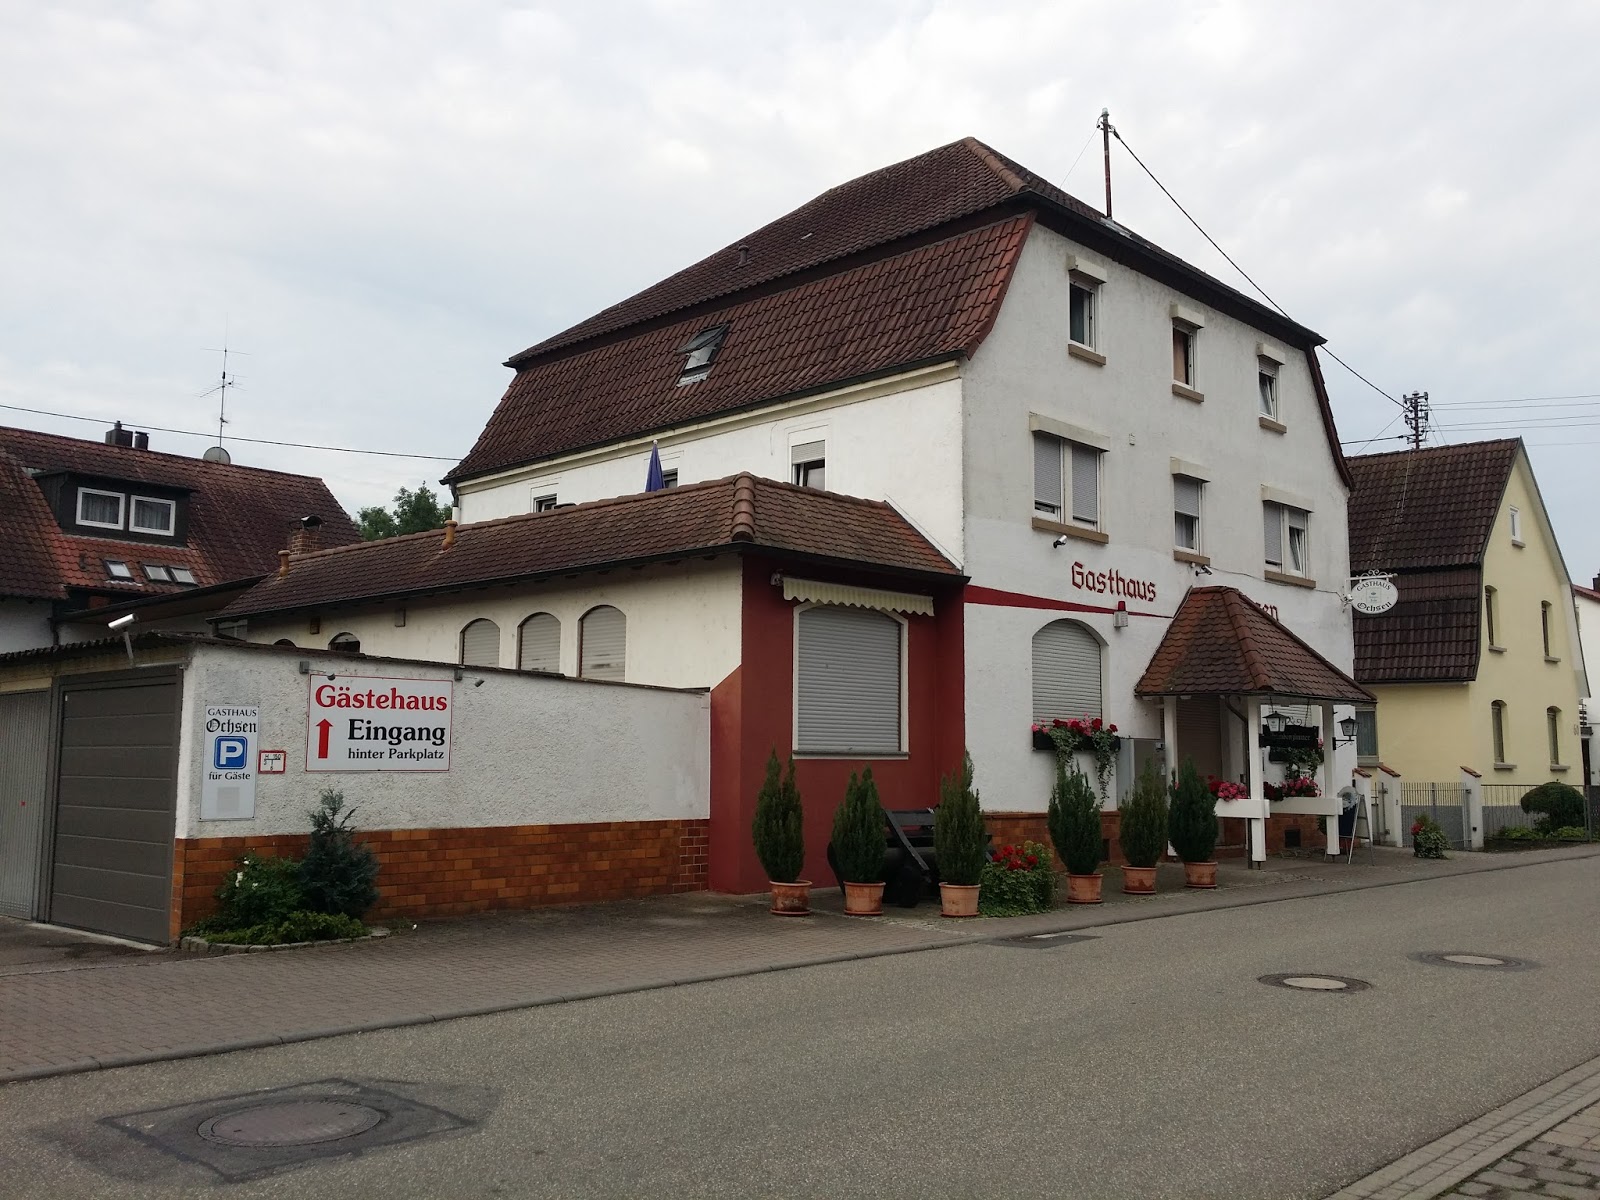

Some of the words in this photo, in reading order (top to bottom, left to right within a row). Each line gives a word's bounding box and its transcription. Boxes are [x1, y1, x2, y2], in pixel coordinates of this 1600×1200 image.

[1071, 561, 1156, 602] Gasthaus
[1356, 580, 1391, 591] GASTHAUS
[1357, 601, 1392, 612] Ochsen
[315, 684, 448, 711] Gästehaus
[207, 708, 257, 717] GASTHAUS
[206, 718, 257, 735] Ochsen
[347, 718, 446, 746] Eingang
[219, 740, 244, 765] P
[347, 747, 385, 759] hinter
[388, 747, 445, 761] Parkplatz
[208, 771, 222, 780] für
[224, 771, 251, 780] Gäste
